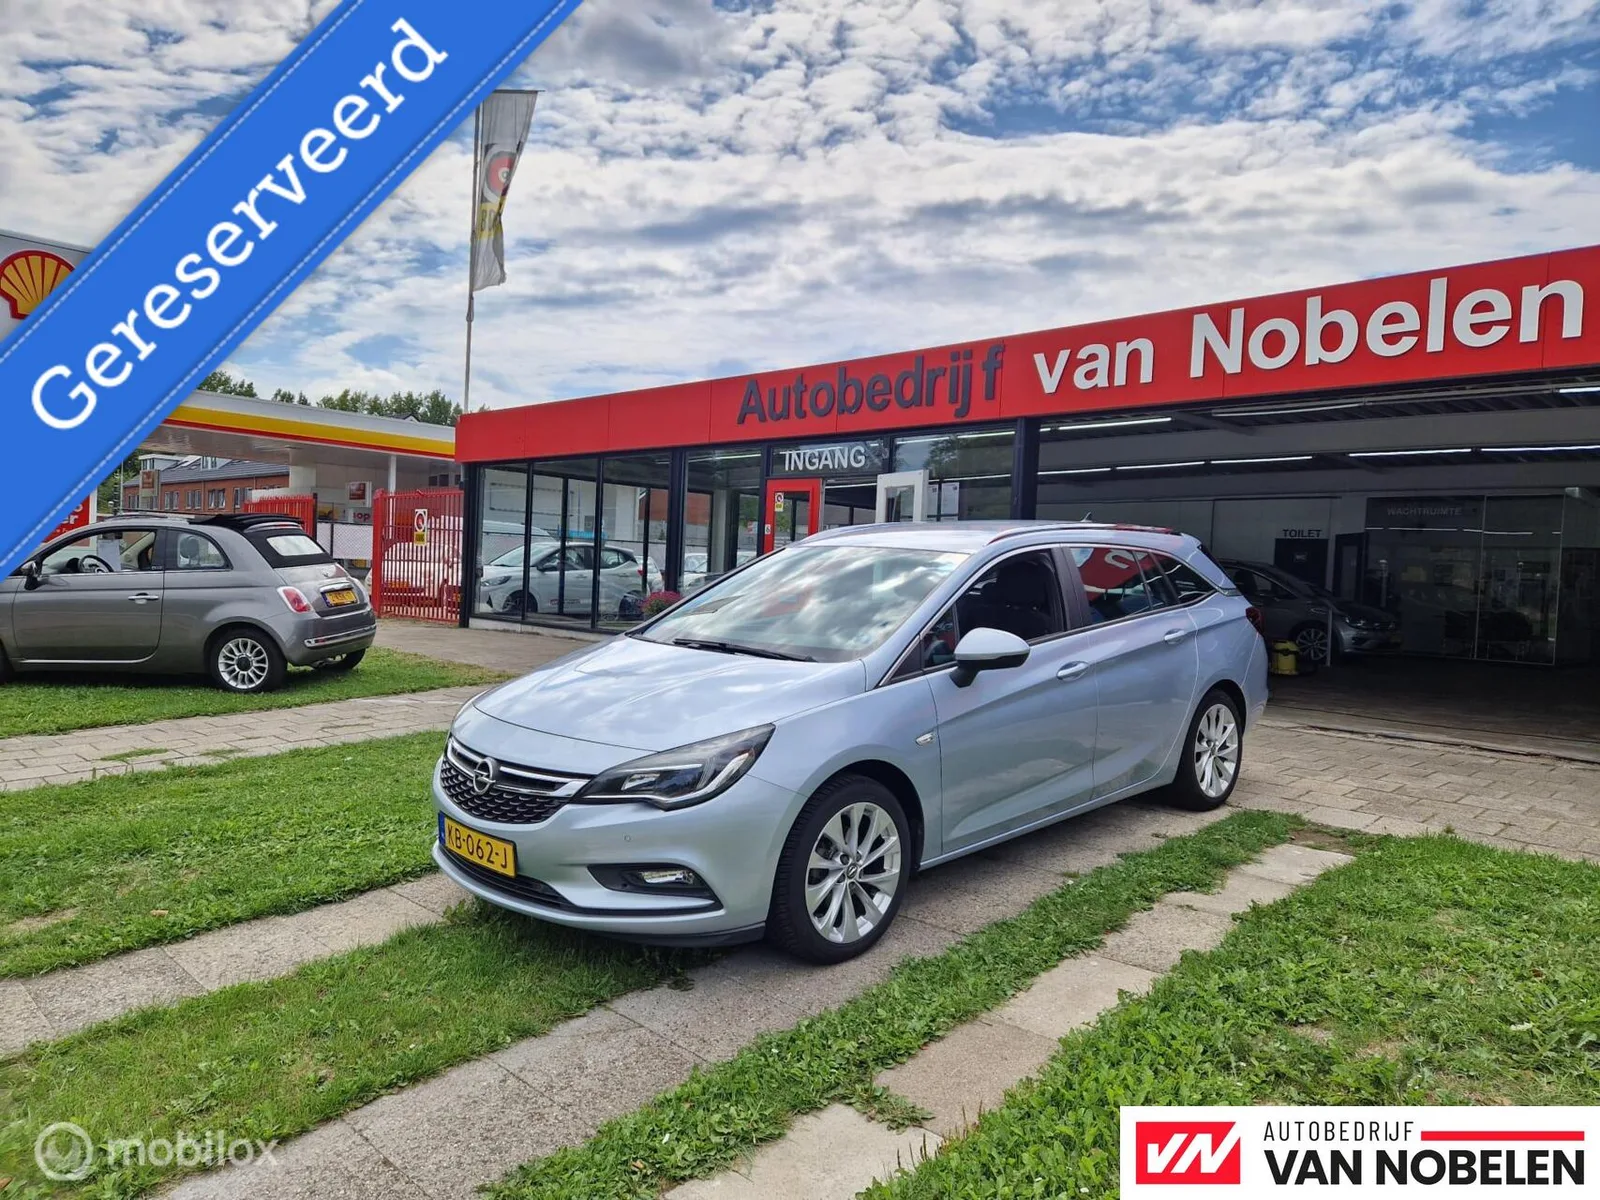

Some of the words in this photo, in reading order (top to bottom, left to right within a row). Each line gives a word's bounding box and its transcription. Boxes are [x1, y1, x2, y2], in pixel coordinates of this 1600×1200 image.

[737, 344, 1005, 424] Autobedrijf
[1033, 338, 1154, 394] van
[1190, 277, 1584, 378] Nobelen
[784, 446, 866, 471] INGANG
[1387, 507, 1462, 516] WACHTRUIMTE
[1283, 529, 1322, 538] TOILET
[448, 823, 507, 869] KB-062-J
